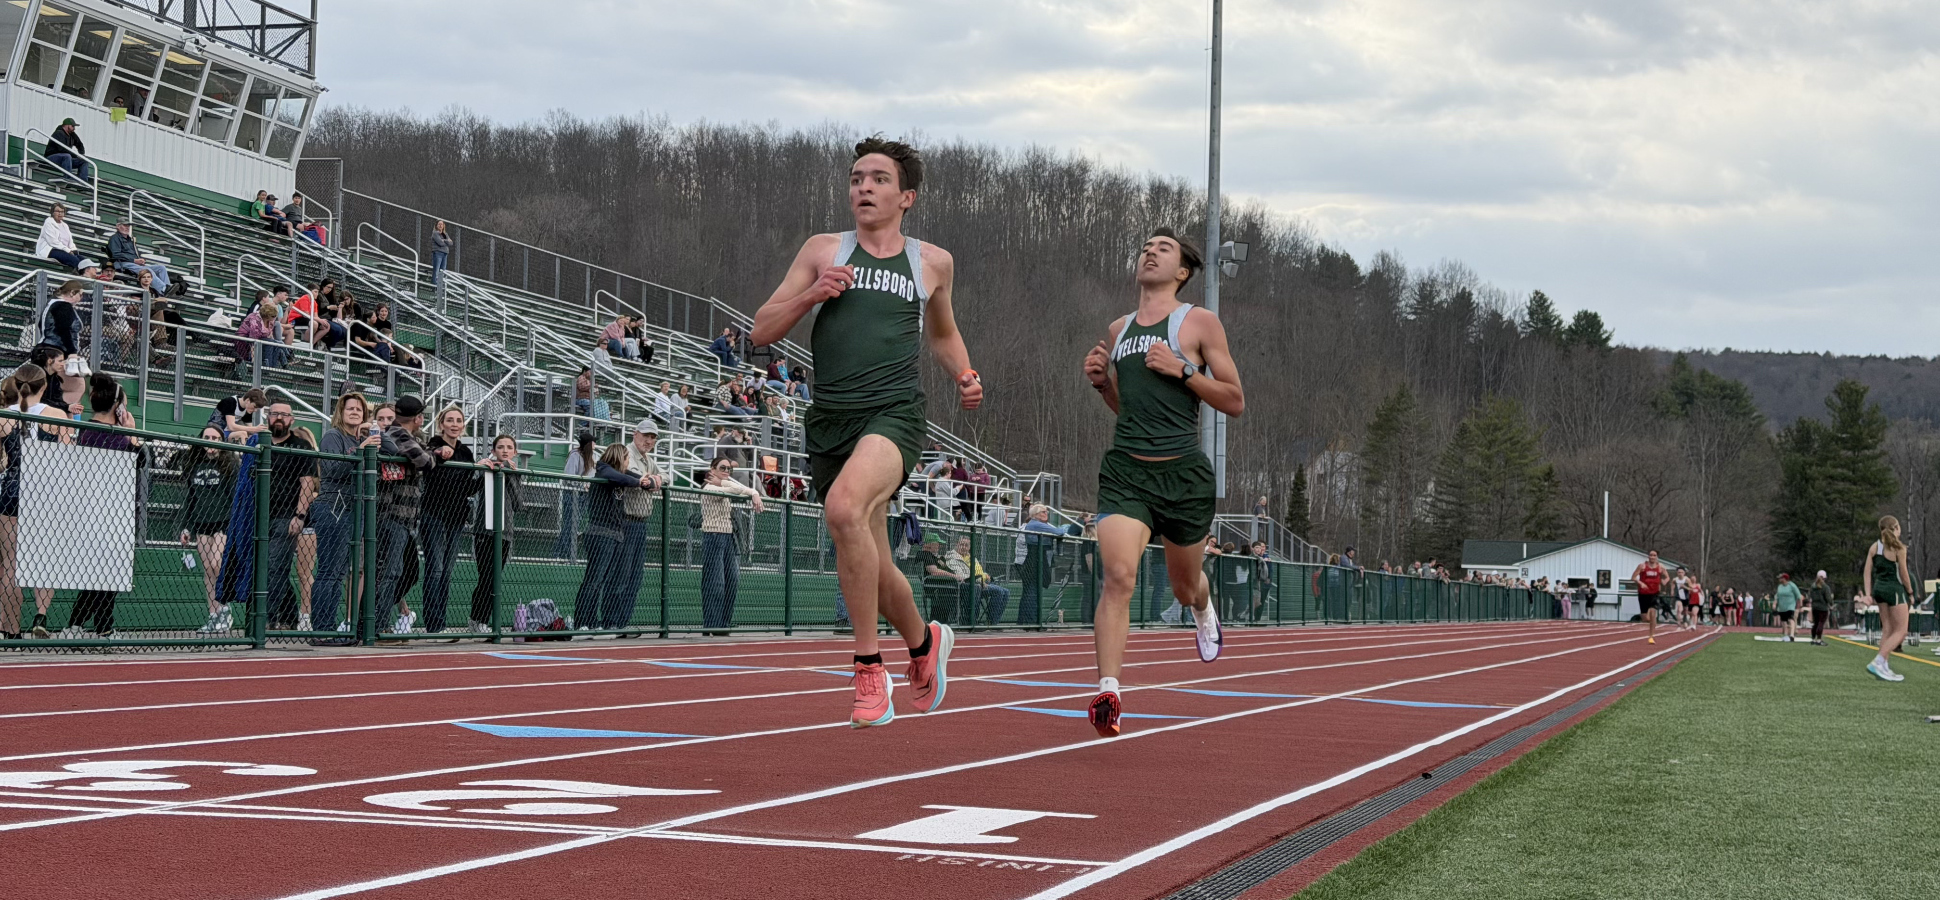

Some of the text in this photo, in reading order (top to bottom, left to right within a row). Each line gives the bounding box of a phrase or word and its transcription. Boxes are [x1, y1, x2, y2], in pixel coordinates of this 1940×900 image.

[848, 266, 914, 302] ELLSBORO
[0, 758, 318, 791] 3
[362, 779, 722, 815] 2
[854, 804, 1099, 845] 1
[894, 854, 1092, 875] FINISH
